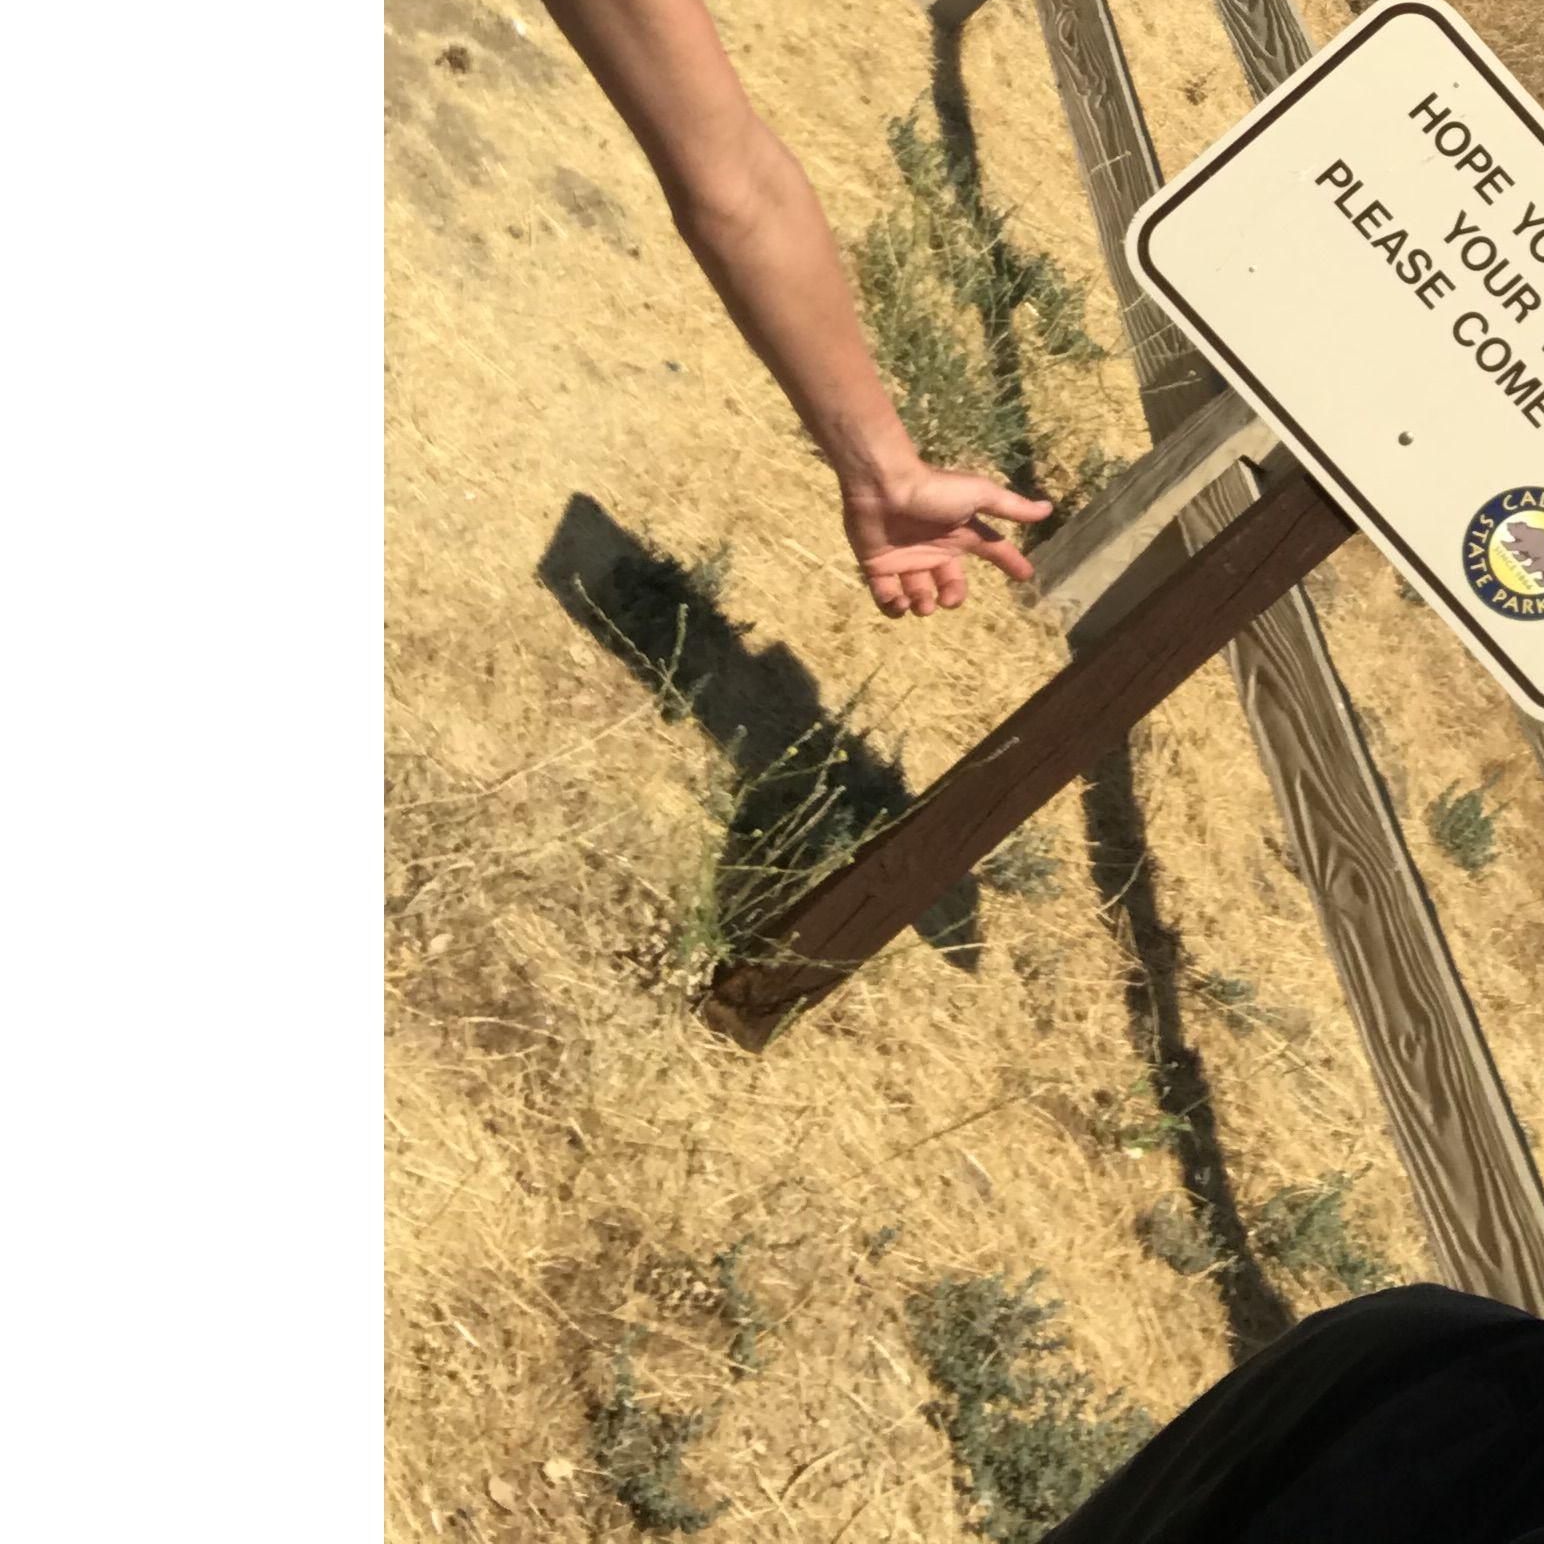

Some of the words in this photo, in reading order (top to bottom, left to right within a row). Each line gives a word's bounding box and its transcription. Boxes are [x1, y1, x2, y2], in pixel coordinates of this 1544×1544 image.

[1409, 93, 1515, 205] HOPE
[1315, 159, 1456, 309] PLEASE
[1444, 210, 1541, 323] YOUR
[1468, 514, 1494, 588] STATE
